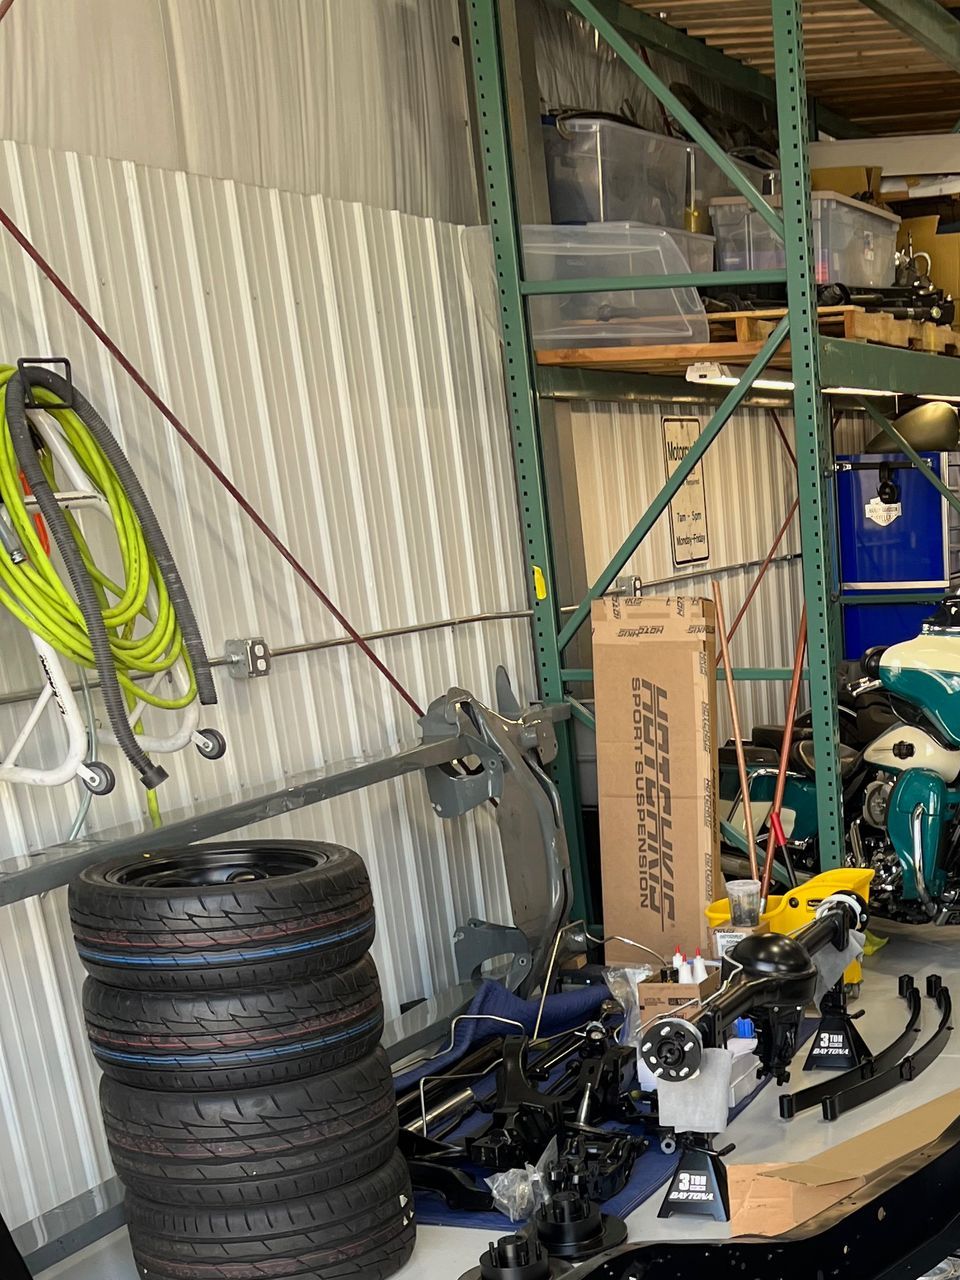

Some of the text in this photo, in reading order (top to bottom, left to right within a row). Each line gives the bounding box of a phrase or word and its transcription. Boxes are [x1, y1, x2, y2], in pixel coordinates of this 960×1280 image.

[631, 676, 649, 909] SPORT SUSPENSION
[641, 678, 676, 922] HOTCHKIS
[820, 1033, 829, 1047] 3
[830, 1034, 843, 1043] TON
[679, 1173, 707, 1191] 3 TON
[669, 1191, 714, 1201] DAYTONA
